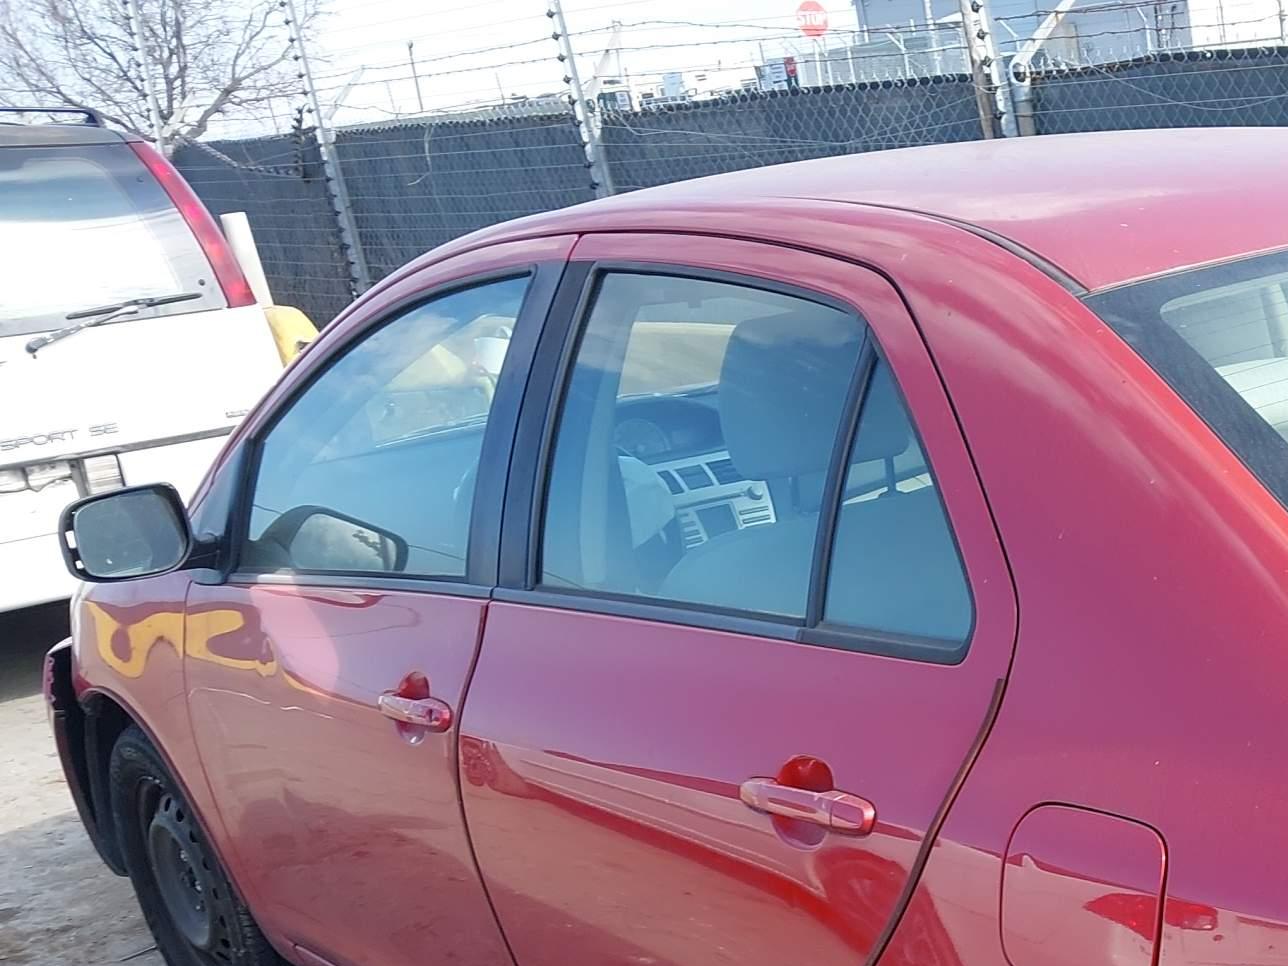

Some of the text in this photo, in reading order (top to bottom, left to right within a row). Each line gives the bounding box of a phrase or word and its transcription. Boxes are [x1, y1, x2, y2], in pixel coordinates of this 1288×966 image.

[797, 11, 827, 27] STOP
[0, 423, 119, 451] SPORT SE
